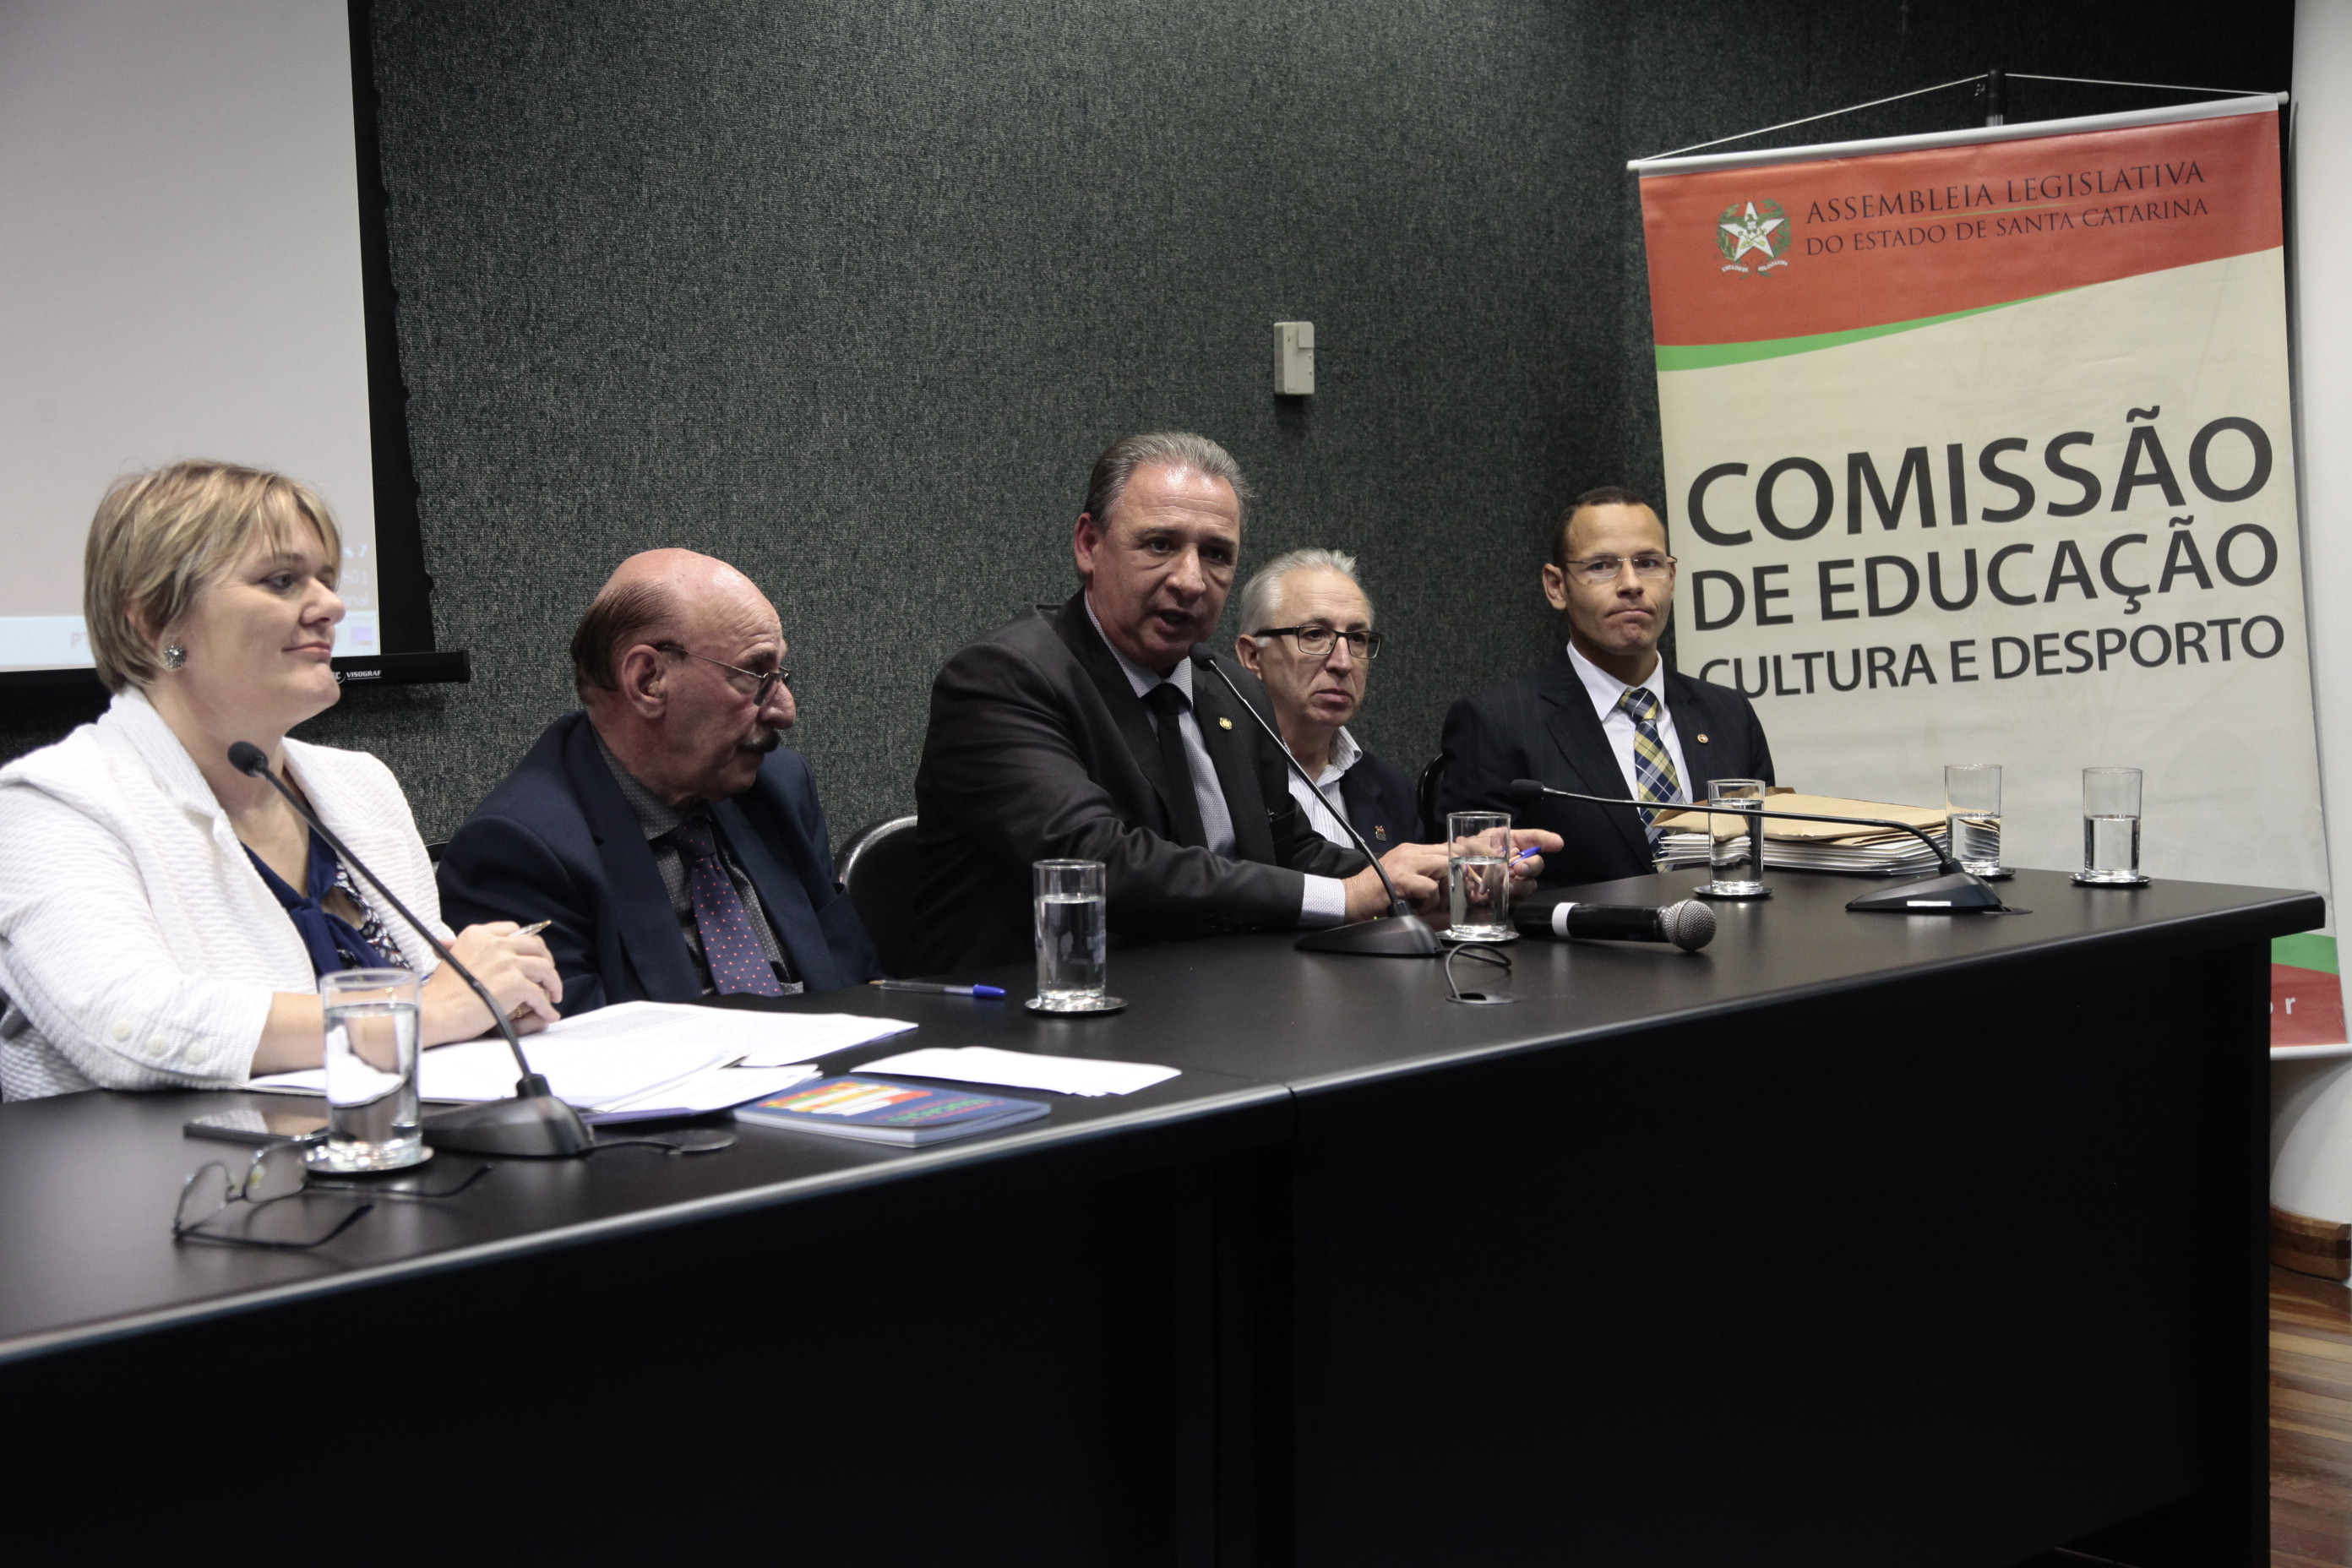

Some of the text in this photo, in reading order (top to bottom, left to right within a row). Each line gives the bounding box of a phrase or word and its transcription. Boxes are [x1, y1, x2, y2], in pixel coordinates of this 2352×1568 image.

[1805, 161, 2207, 224] ASSEMBLEIA LEGISLATIVA
[1806, 198, 2208, 255] DO ESTADO DE SANTA CATARINA
[1688, 406, 2273, 547] COMISSÃO
[1691, 514, 2278, 631] DE EDUCAÇÃO
[1699, 615, 2285, 699] CULTURA E DESPORTO
